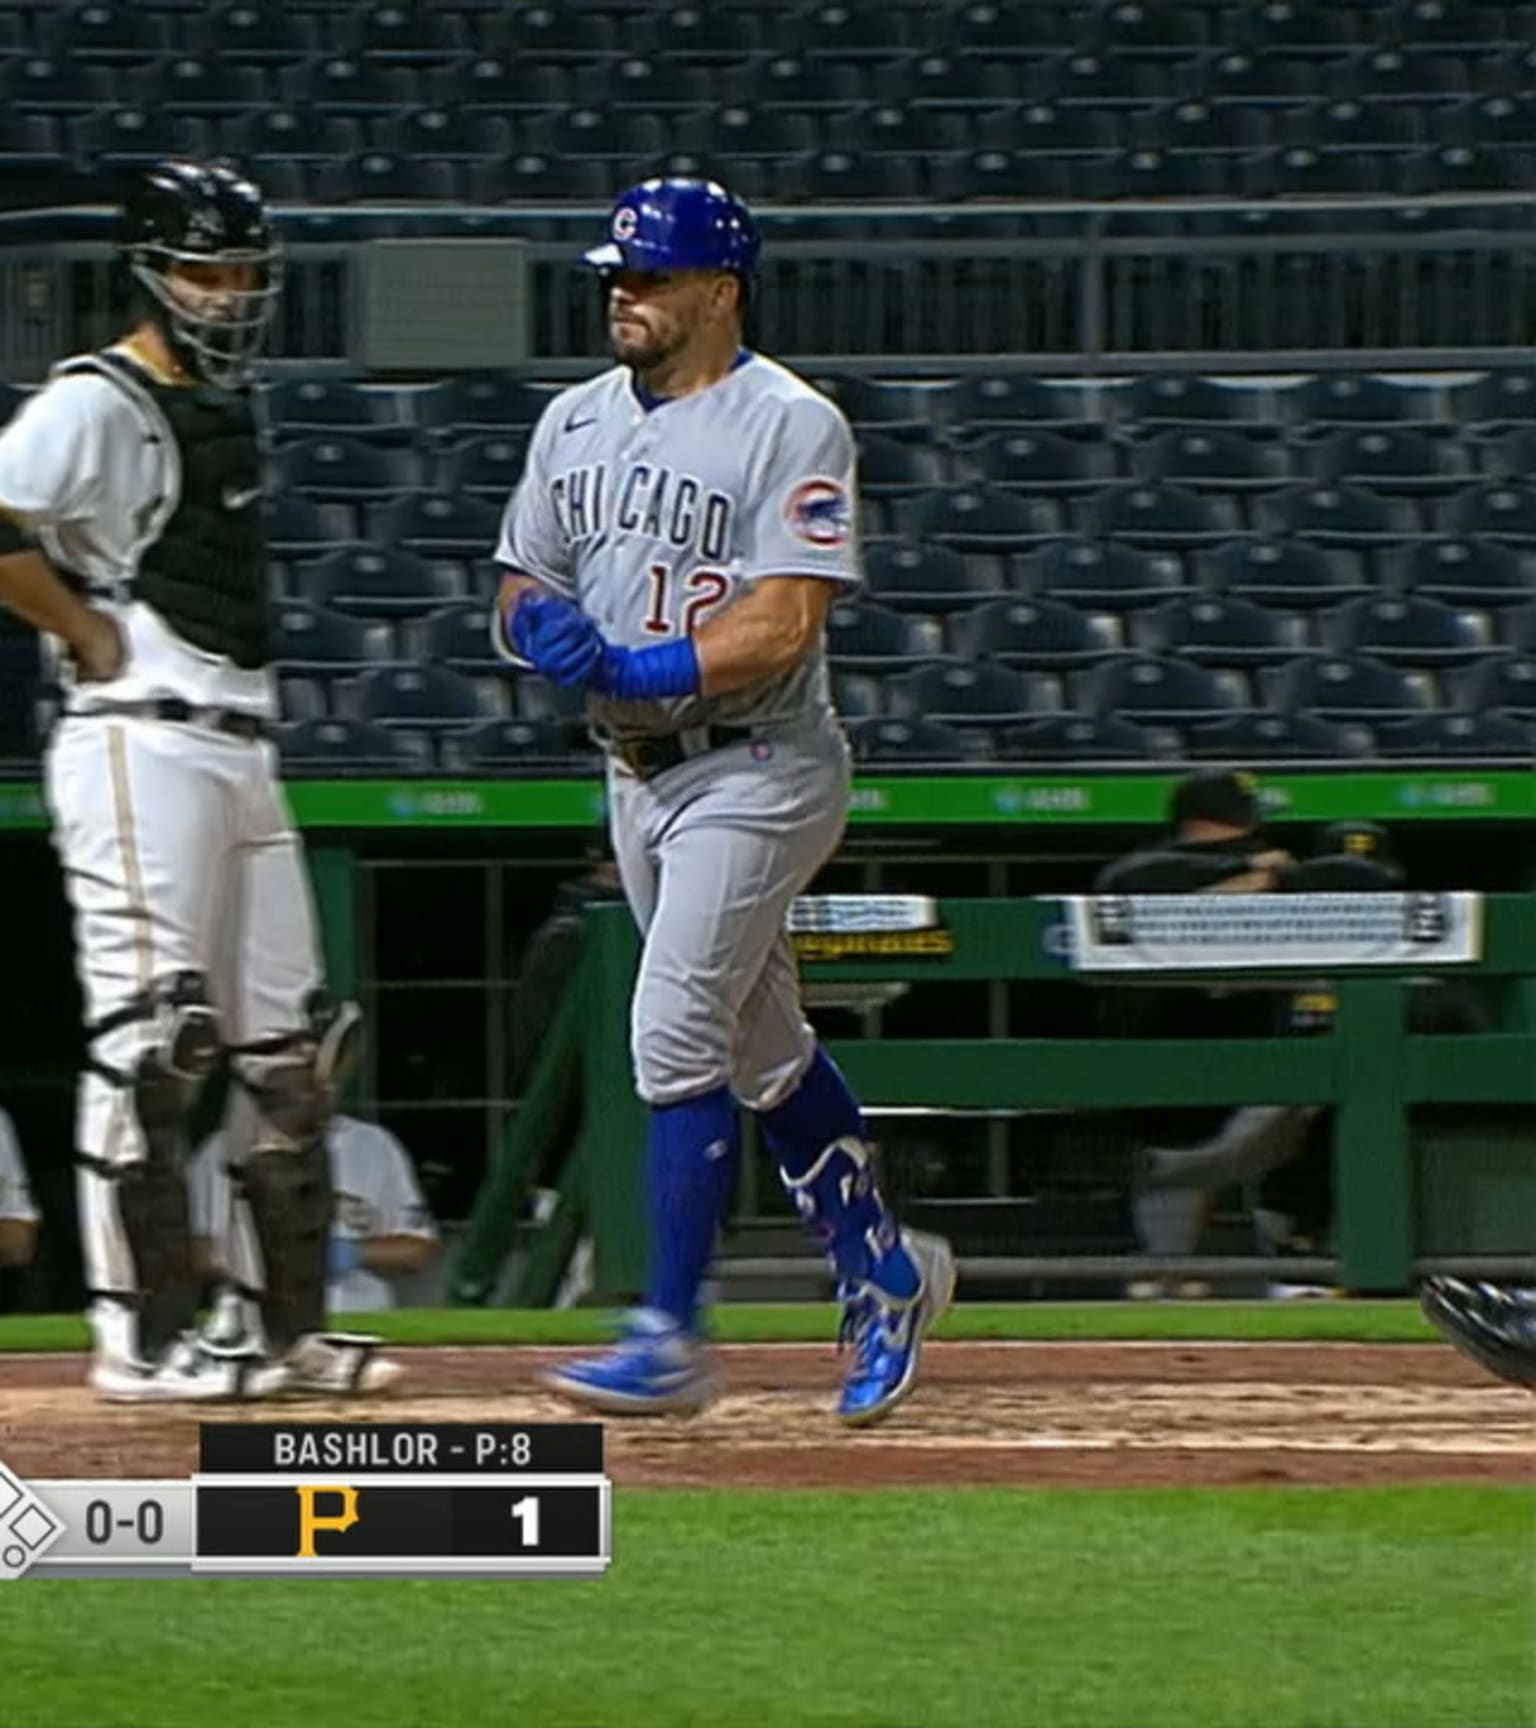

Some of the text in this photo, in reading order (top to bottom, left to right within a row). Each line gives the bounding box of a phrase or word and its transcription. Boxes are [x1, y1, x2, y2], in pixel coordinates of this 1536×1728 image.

[613, 207, 638, 241] C
[551, 463, 734, 562] CHICAGO
[642, 563, 731, 636] 12
